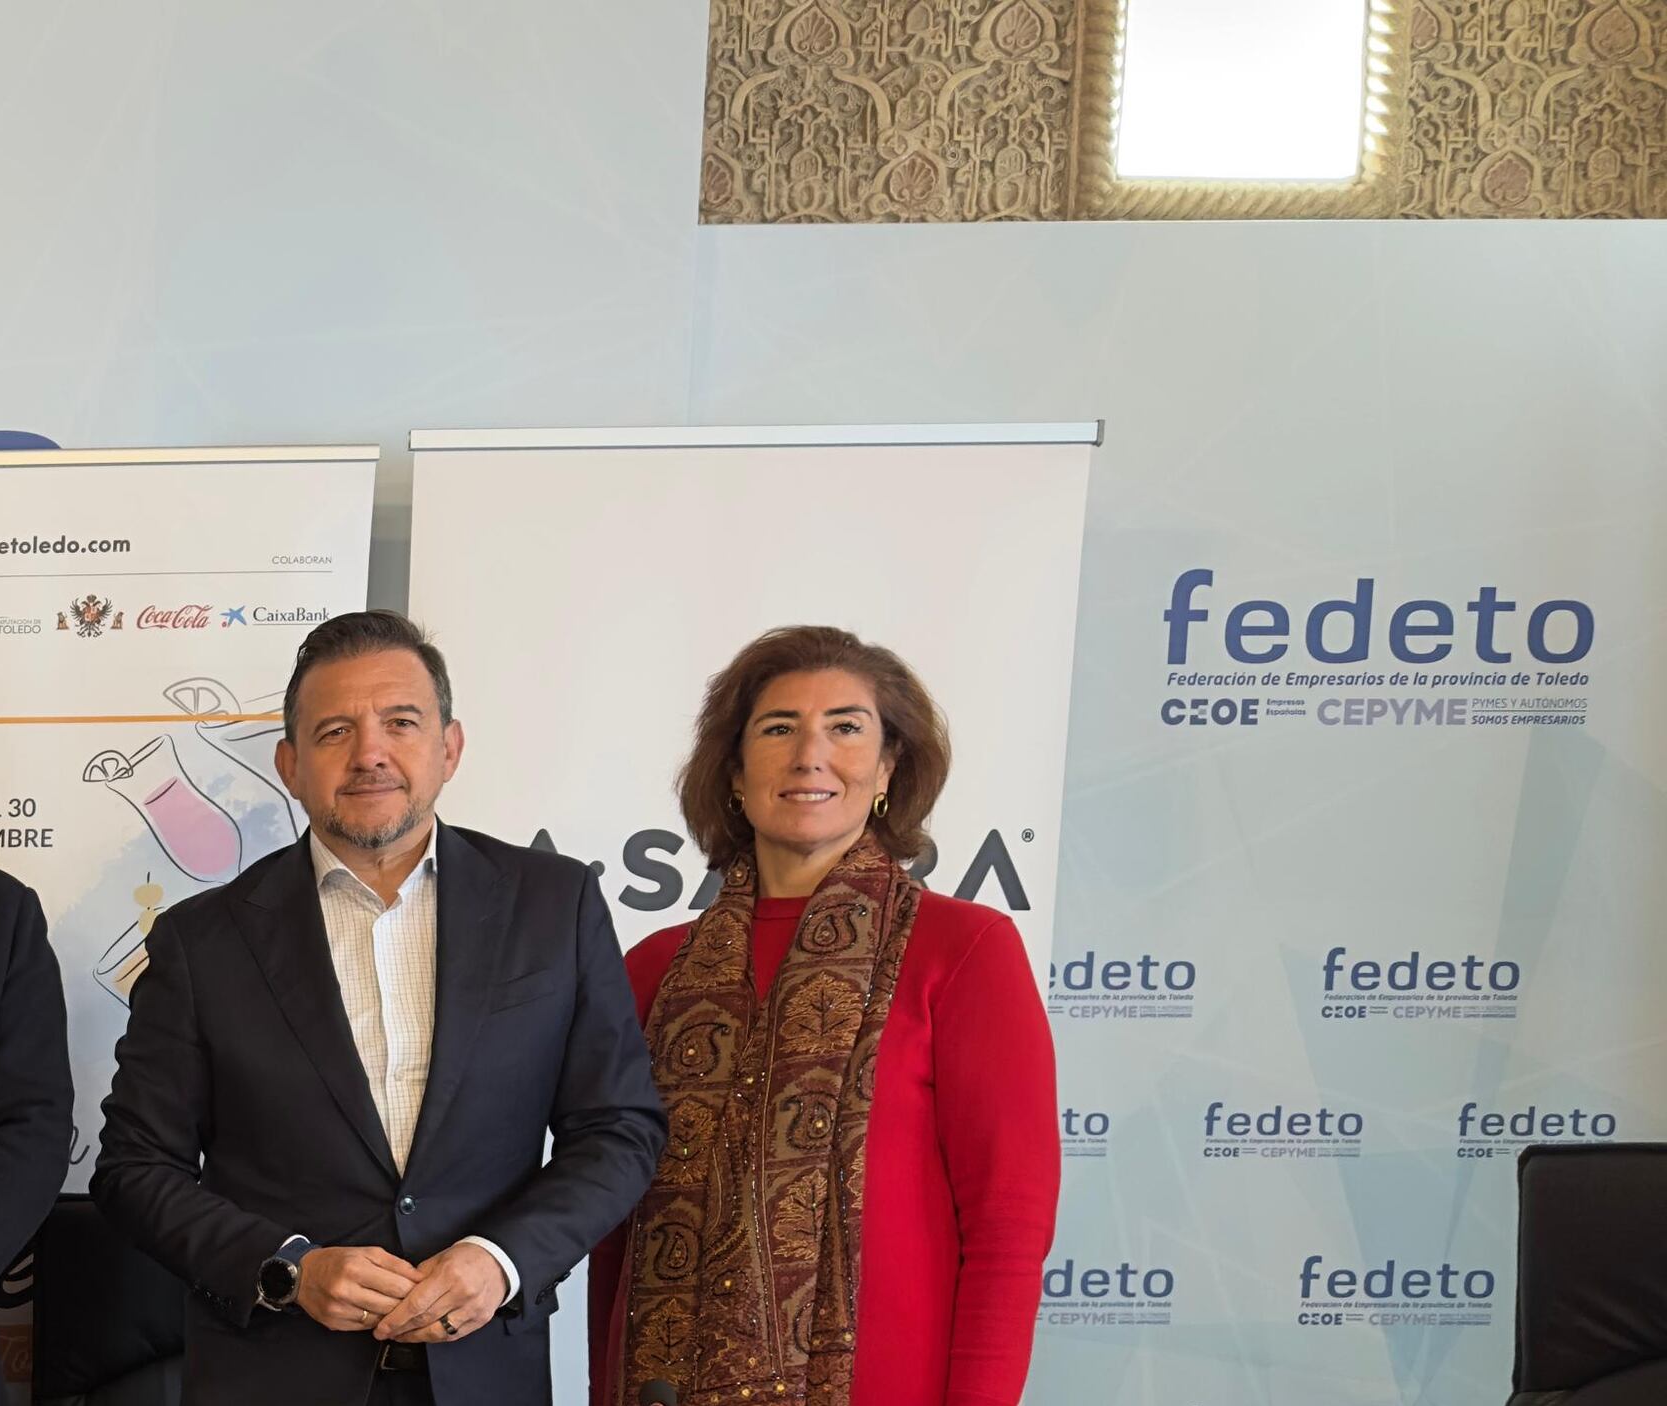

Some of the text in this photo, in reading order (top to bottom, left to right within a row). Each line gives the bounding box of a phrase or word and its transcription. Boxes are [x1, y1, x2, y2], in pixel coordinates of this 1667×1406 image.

[271, 556, 333, 565] COLABORAN
[252, 606, 330, 622] CaixaBank
[1163, 568, 1595, 665] fedeto
[1167, 672, 1589, 688] Federación de Empresarios de la provincia de Toledo
[1472, 697, 1588, 709] PYMES AUTÓNOMOS
[1161, 698, 1260, 726] CEOE
[1317, 698, 1467, 726] CEPYME
[1471, 715, 1586, 725] SOMOS EMPRESARIOS
[8, 798, 36, 818] 30
[1050, 951, 1196, 990] deto
[1323, 947, 1520, 991] fedeto
[1069, 1006, 1137, 1018] CEPYME
[1321, 1005, 1367, 1019] CEOE
[1393, 1005, 1462, 1019] CEPYME
[1204, 1102, 1363, 1137] fedeto
[1458, 1102, 1616, 1137] fedeto
[1261, 1147, 1317, 1158] CEPYME
[1043, 1259, 1174, 1298] deto
[1300, 1255, 1495, 1299] fedeto
[1048, 1313, 1117, 1325] CEPYME
[1369, 1313, 1437, 1326] CEPYME
